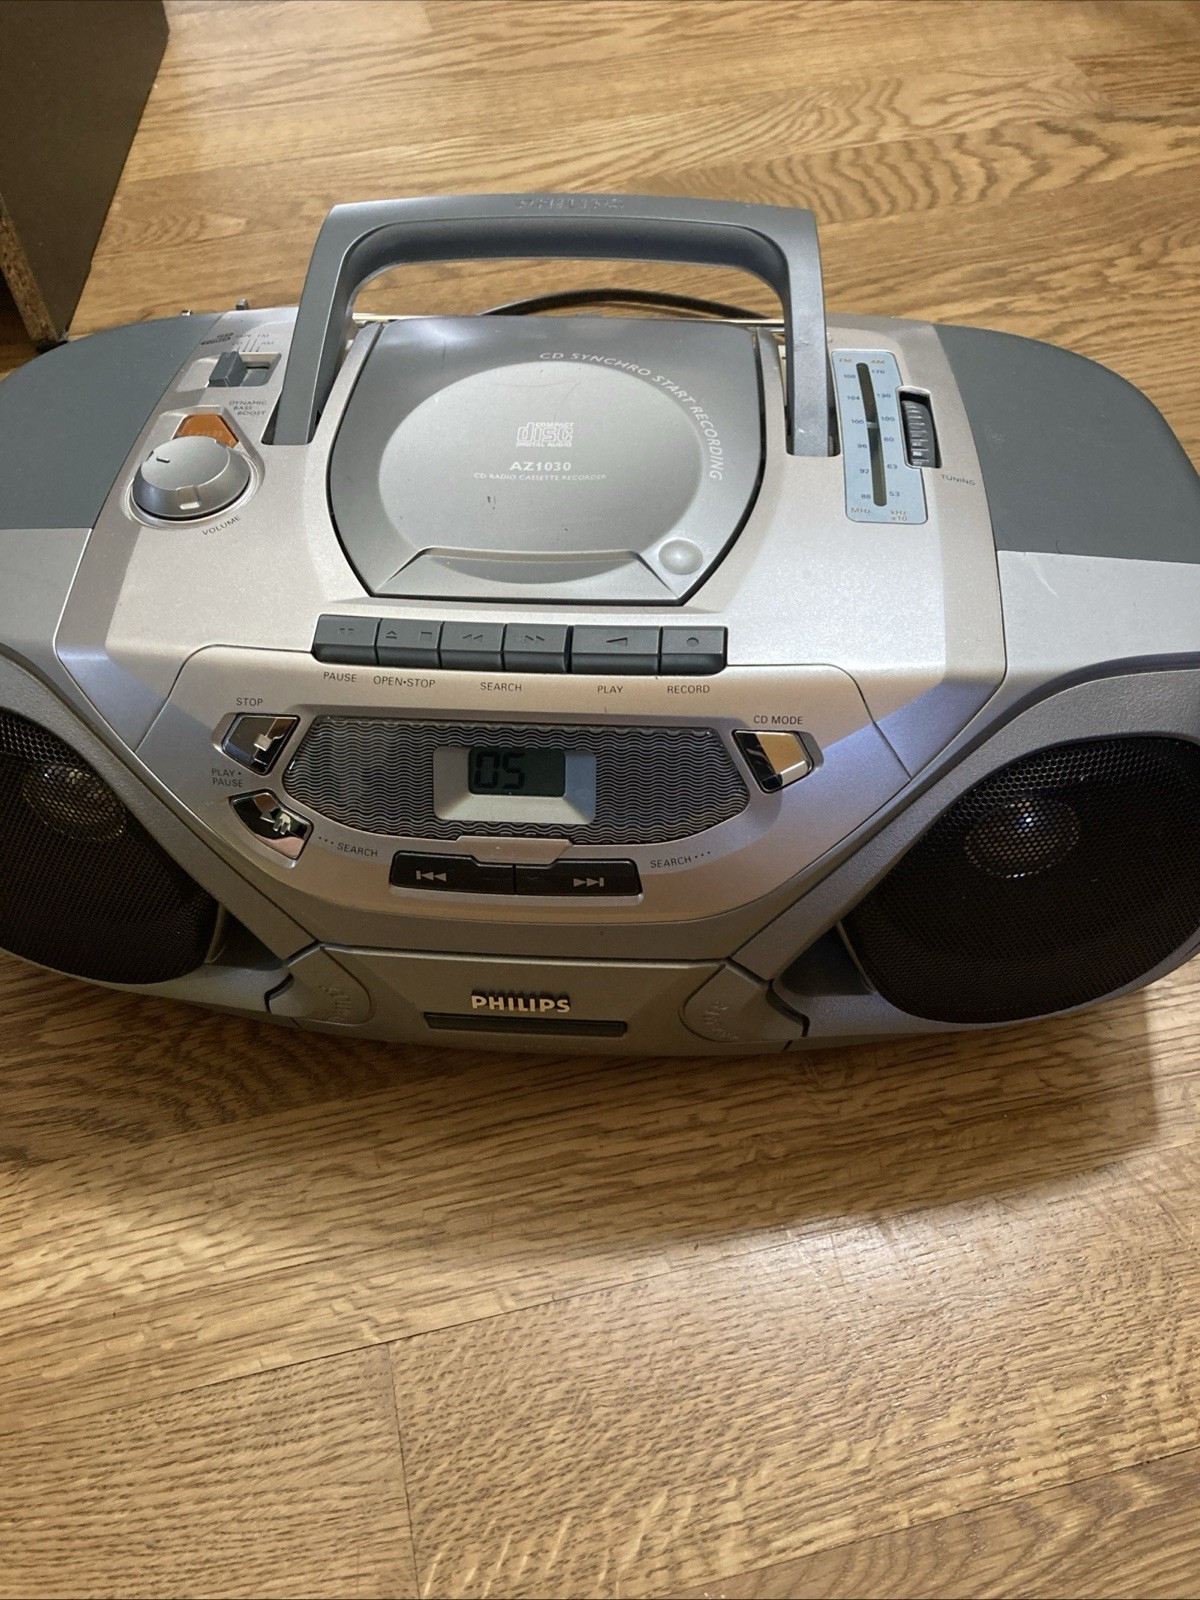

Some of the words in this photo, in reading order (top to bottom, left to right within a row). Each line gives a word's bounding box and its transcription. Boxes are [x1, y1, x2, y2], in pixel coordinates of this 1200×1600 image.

[540, 352, 564, 360] CD
[570, 352, 651, 377] SYNCHRO
[652, 375, 697, 404] START
[689, 405, 725, 482] RECORDING
[509, 461, 572, 471] AZ1030
[941, 474, 976, 486] TUNING
[201, 515, 242, 536] VOLUME
[323, 671, 357, 683] PAUSE
[480, 682, 522, 692] SEARCH
[597, 685, 623, 694] PLAY
[667, 685, 710, 694] RECORD
[236, 697, 263, 707] STOP
[753, 715, 768, 724] CD
[771, 715, 803, 725] MODE
[474, 751, 526, 790] 05
[212, 777, 243, 788] PAUSE
[337, 842, 378, 858] SEARCH
[650, 856, 692, 869] SEARCH
[471, 995, 571, 1013] PHILIPS
